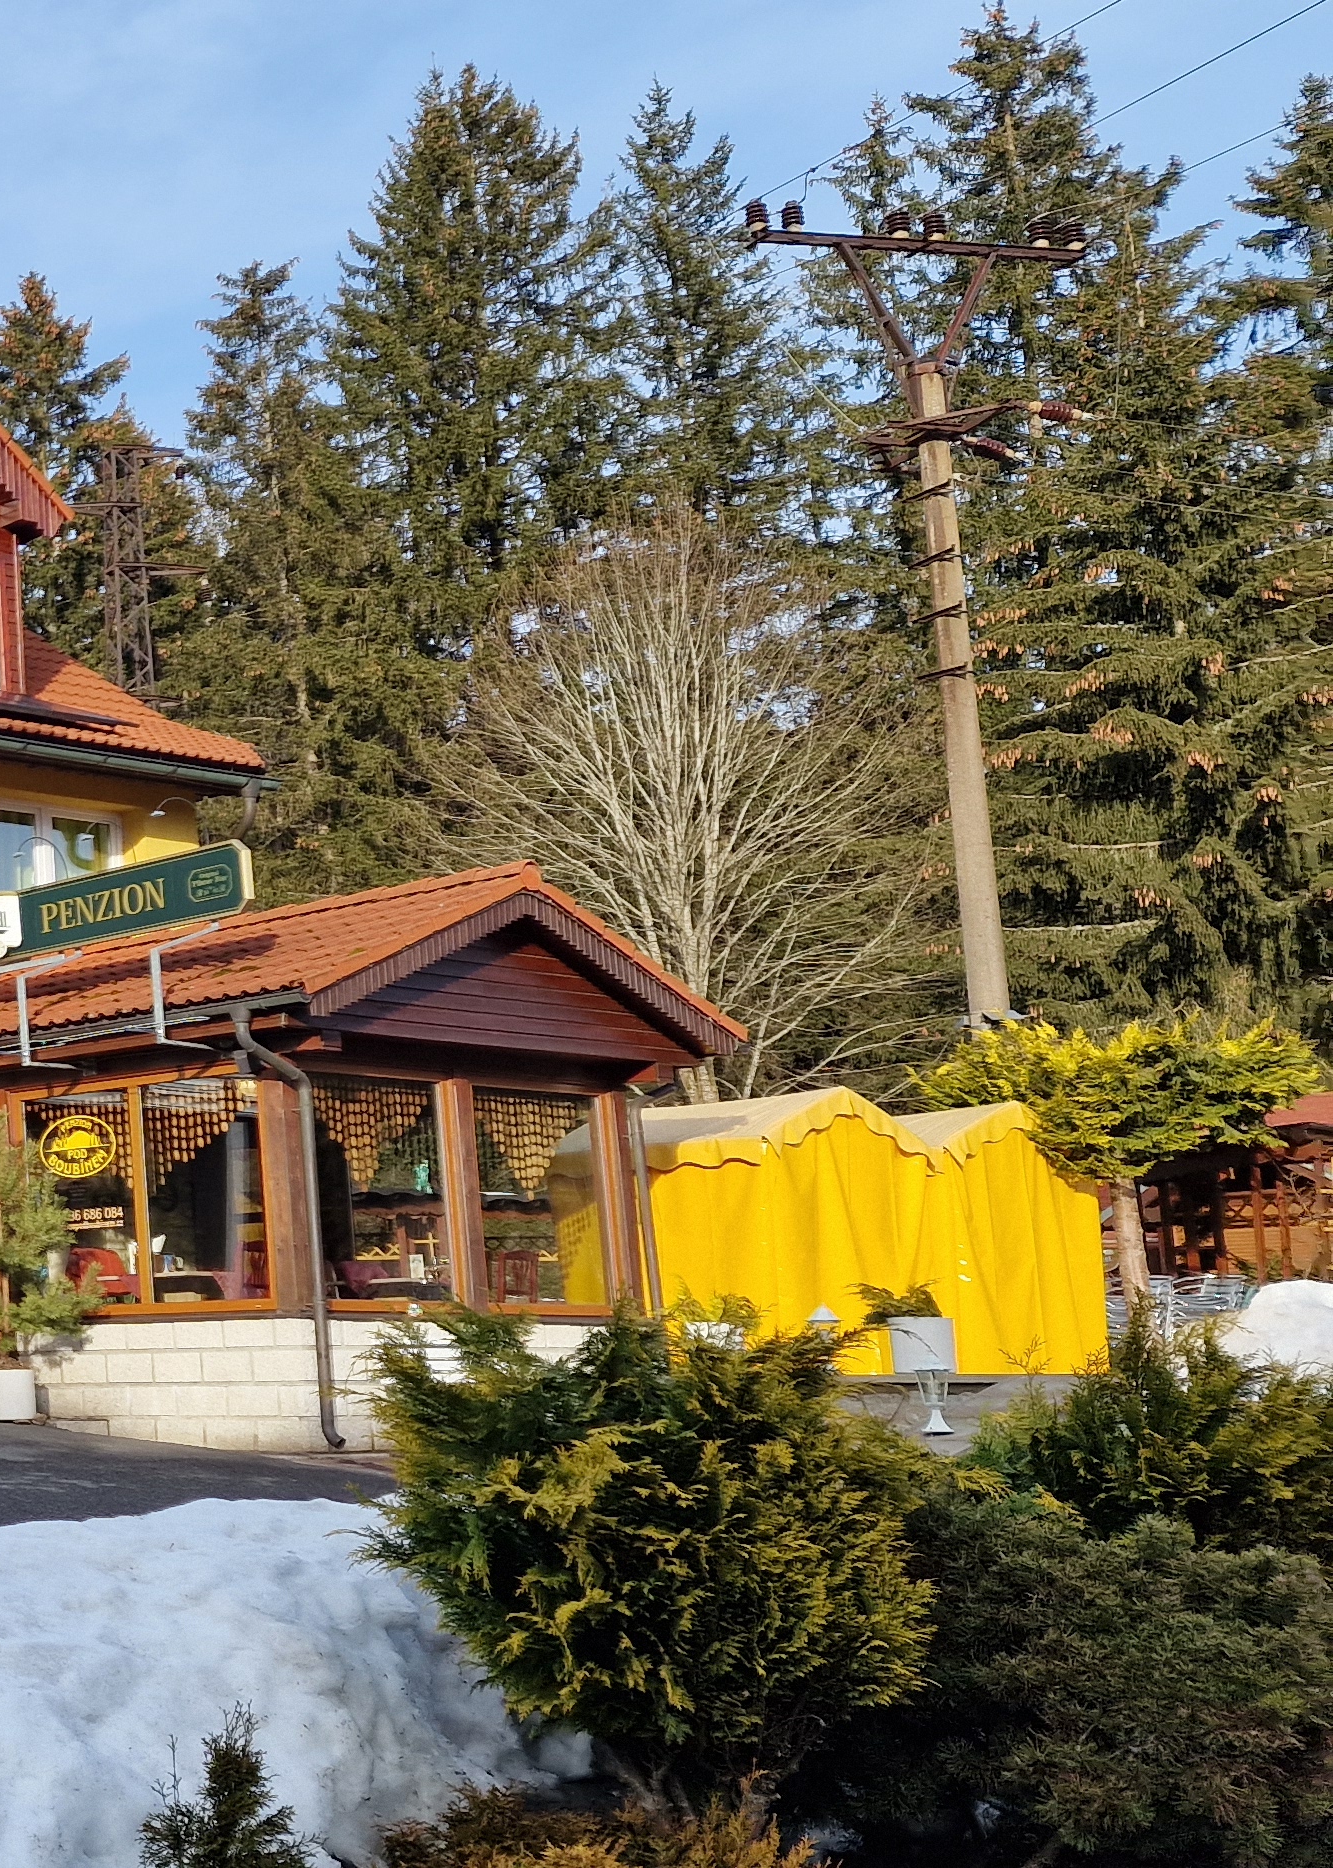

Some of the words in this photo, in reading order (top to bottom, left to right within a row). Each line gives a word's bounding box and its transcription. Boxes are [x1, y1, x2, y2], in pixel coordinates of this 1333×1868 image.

[41, 879, 165, 933] PENZION
[48, 1149, 108, 1175] BOUBÍNEM
[68, 1149, 88, 1160] POD
[84, 1208, 103, 1220] 686
[104, 1206, 124, 1219] 084
